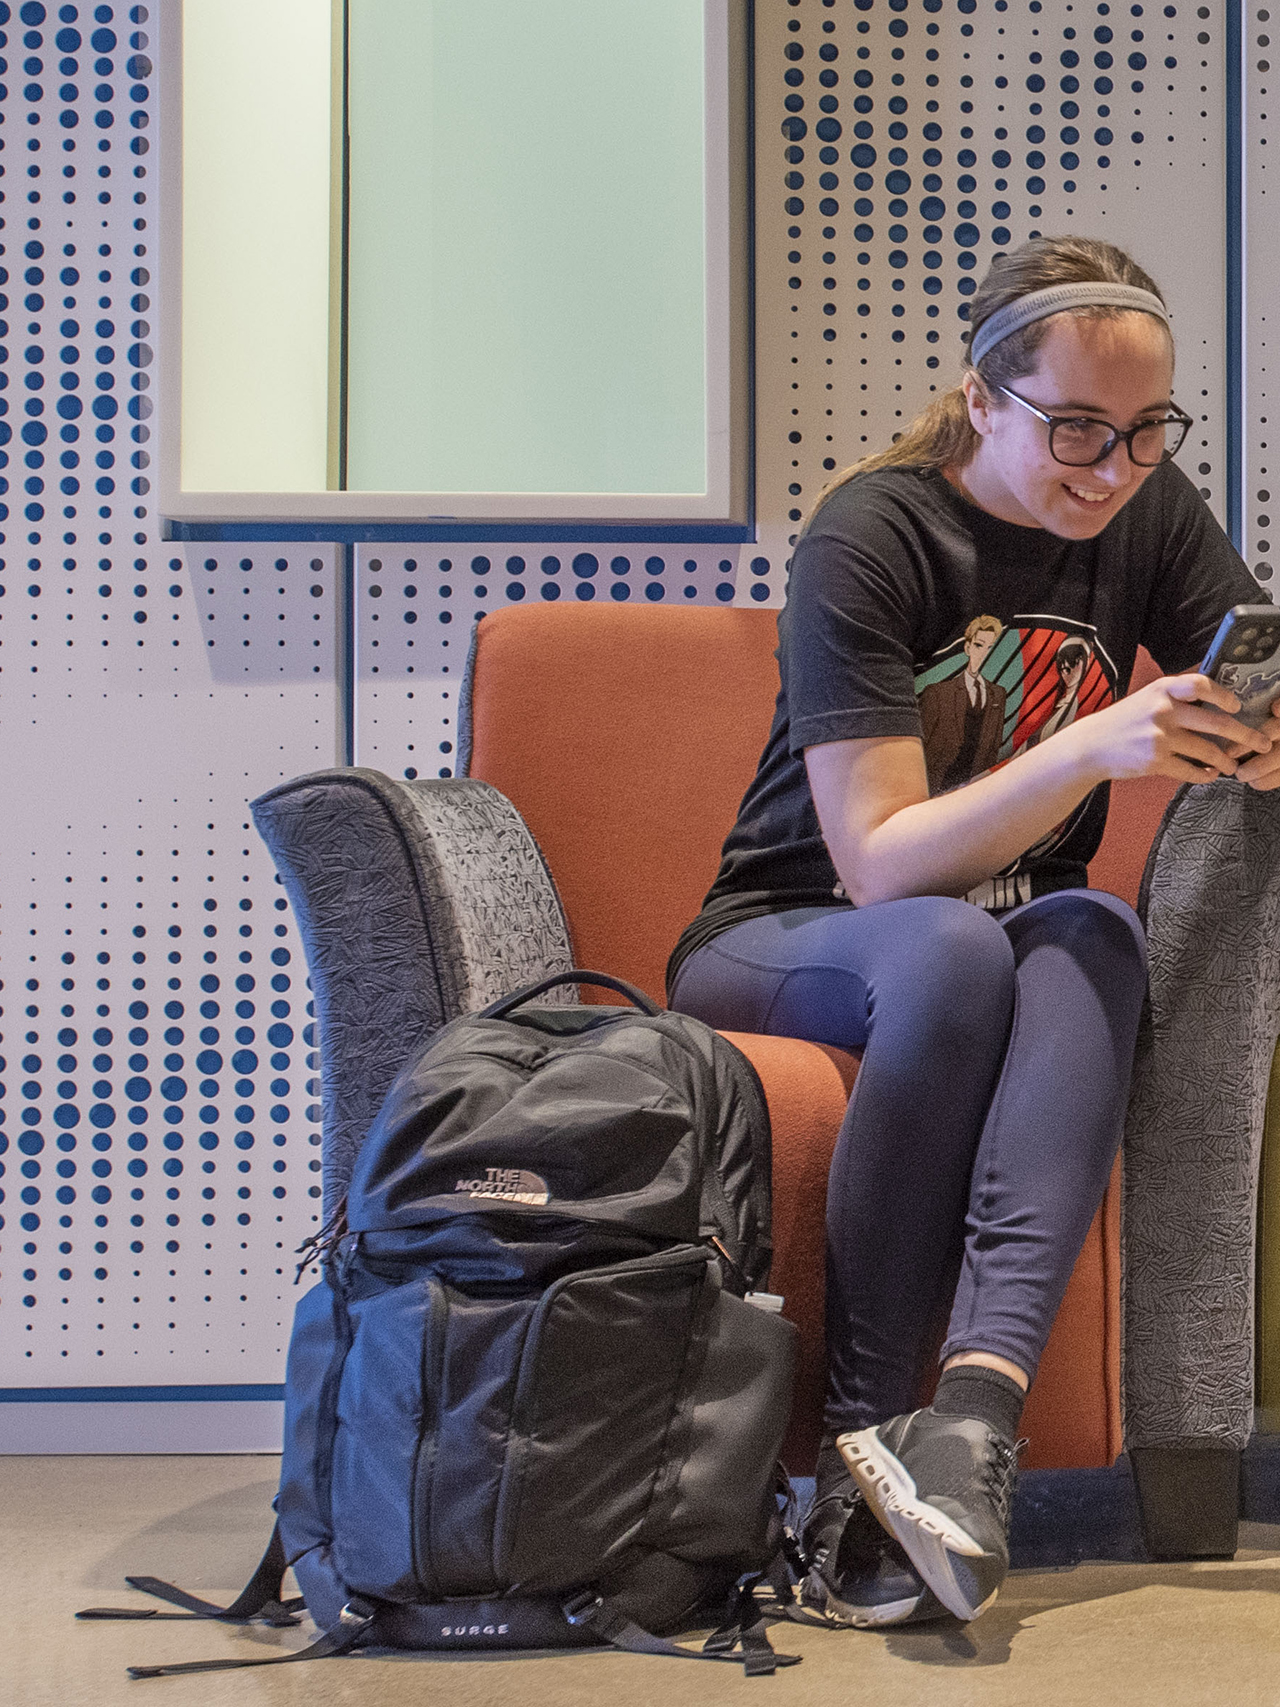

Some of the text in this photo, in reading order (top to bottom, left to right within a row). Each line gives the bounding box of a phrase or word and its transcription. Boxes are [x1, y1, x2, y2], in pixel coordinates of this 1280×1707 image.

[485, 1167, 520, 1182] THE
[454, 1179, 518, 1193] NORTH
[441, 1624, 508, 1636] SURGE
